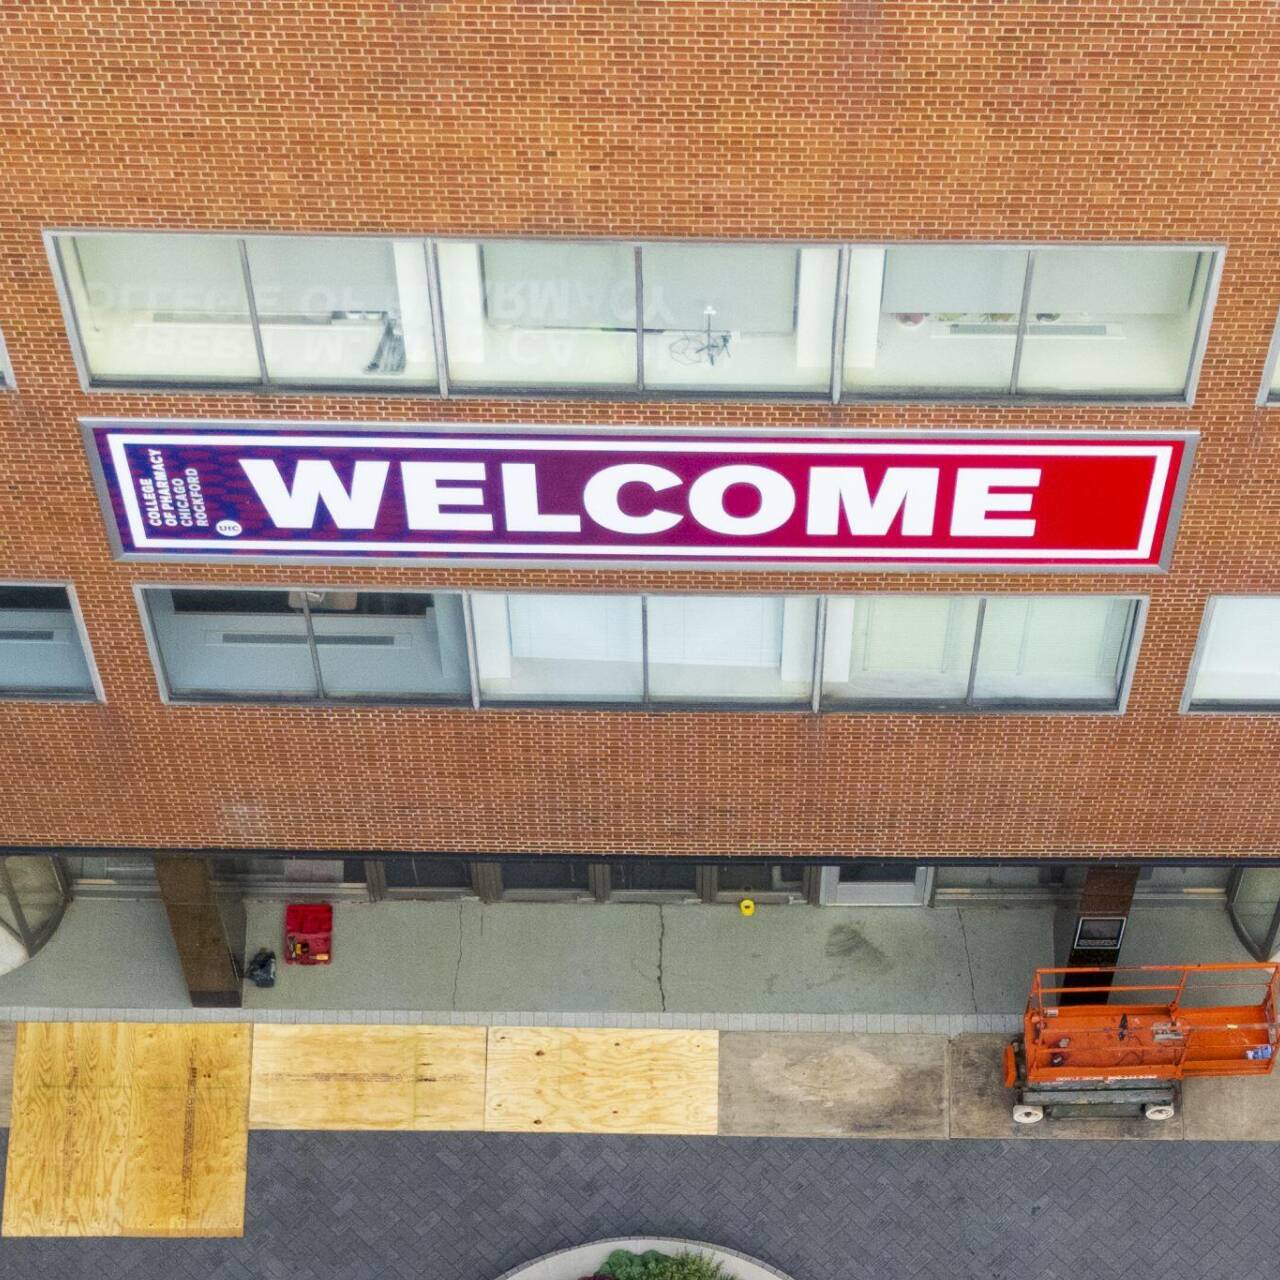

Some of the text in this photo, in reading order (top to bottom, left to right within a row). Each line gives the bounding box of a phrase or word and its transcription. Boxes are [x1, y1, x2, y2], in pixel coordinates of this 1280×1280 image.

[139, 478, 163, 527] COLLEGE
[147, 448, 179, 527] OF PHARMACY
[171, 477, 194, 527] CHICAGO
[184, 467, 210, 527] ROCKFORD
[238, 458, 1042, 537] WELCOME
